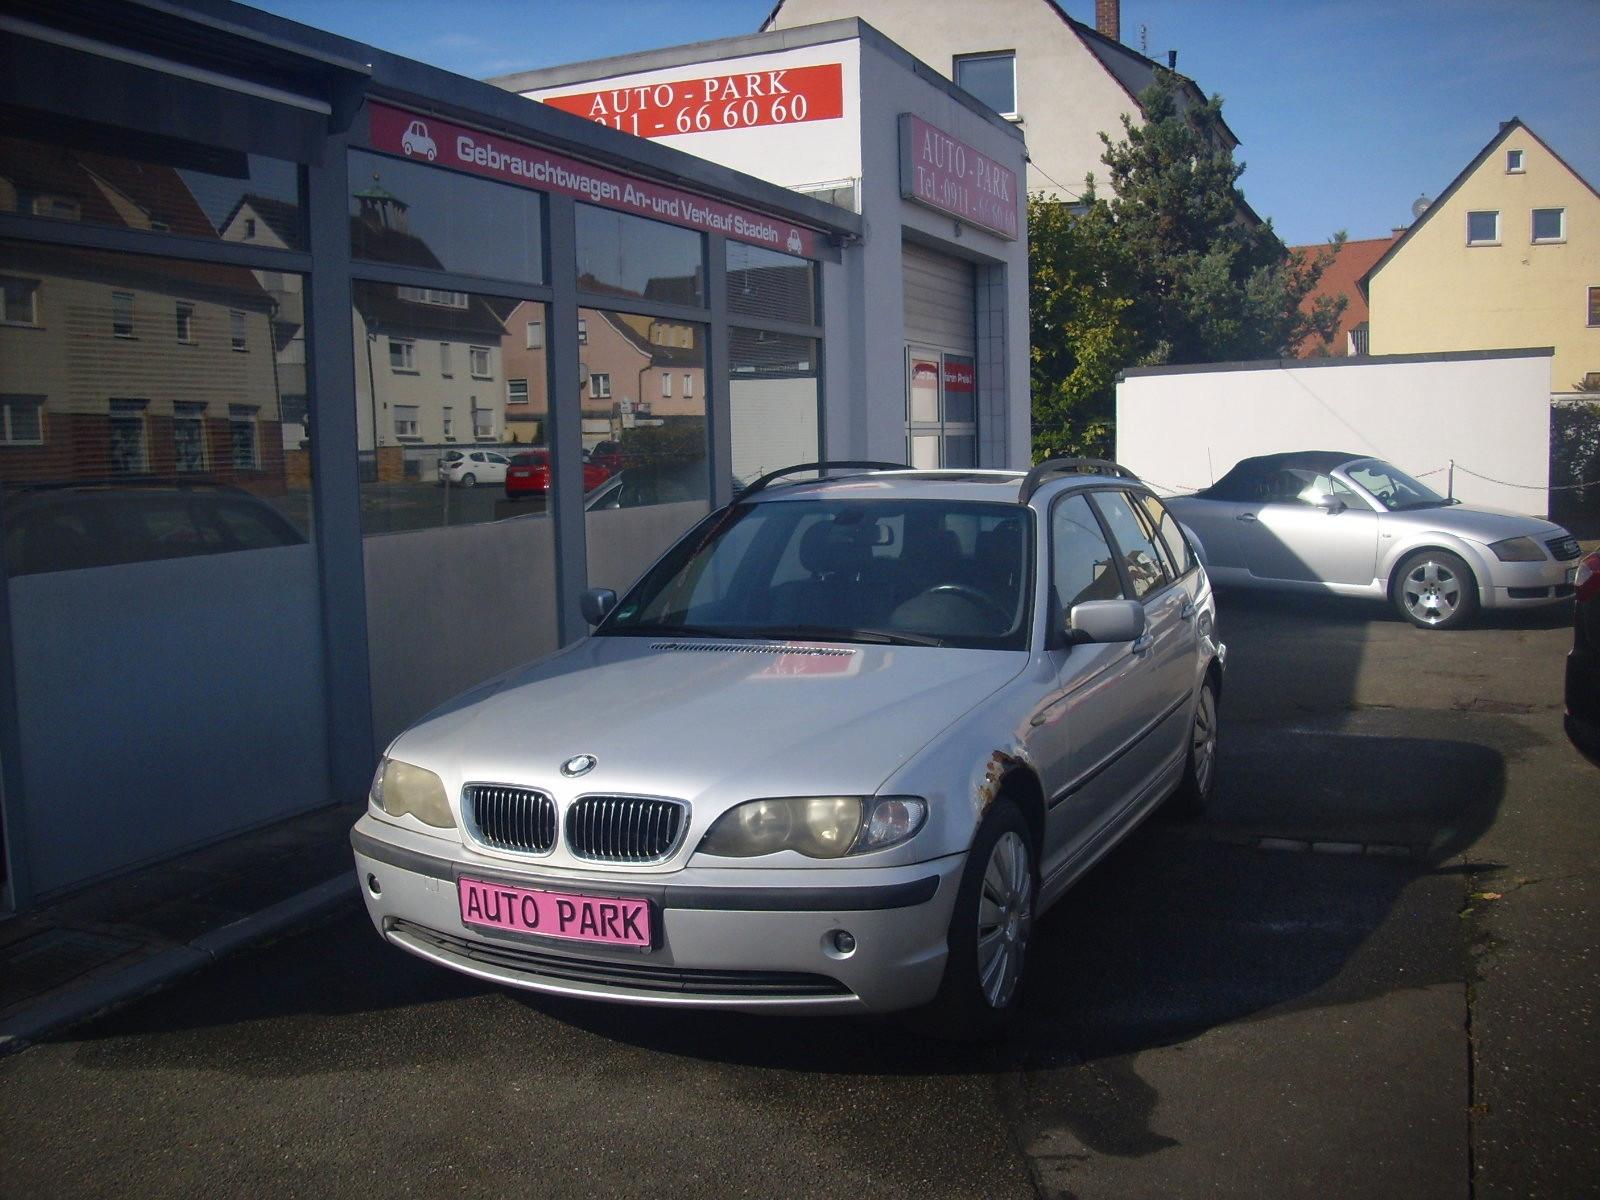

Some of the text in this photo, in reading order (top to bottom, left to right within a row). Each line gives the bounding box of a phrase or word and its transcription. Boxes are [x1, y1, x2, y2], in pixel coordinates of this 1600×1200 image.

[589, 85, 674, 116] AUTO
[703, 71, 790, 102] PARK
[676, 105, 711, 132] 66
[723, 100, 758, 129] 60
[771, 94, 807, 122] 60
[456, 135, 620, 201] Gebrauchtwagen
[681, 200, 733, 231] Verkauf
[734, 215, 779, 242] Stadeln
[922, 129, 966, 178] AUTO
[976, 156, 1009, 202] PARK
[467, 886, 645, 941] AUTO PARK
